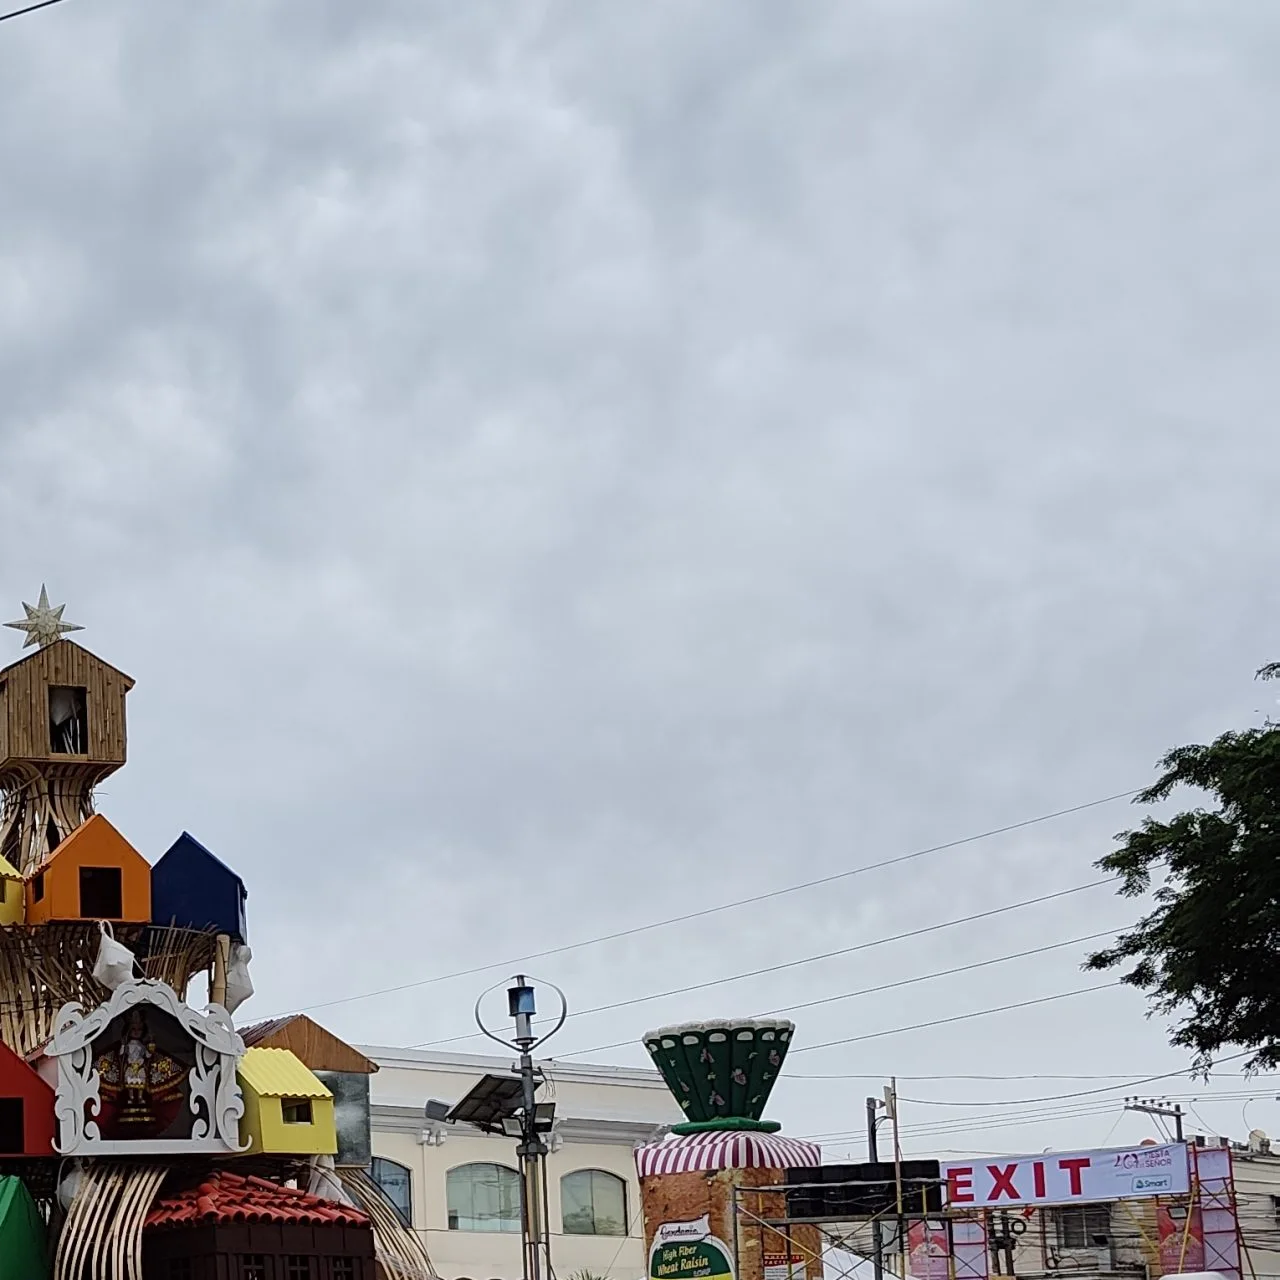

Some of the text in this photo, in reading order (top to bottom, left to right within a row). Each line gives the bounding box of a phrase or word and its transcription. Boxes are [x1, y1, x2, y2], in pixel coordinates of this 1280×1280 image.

[946, 1157, 1091, 1202] EXIT
[1145, 1179, 1168, 1188] Smart
[662, 1246, 697, 1261] High Fiber
[657, 1255, 709, 1276] Wheat Raisin
